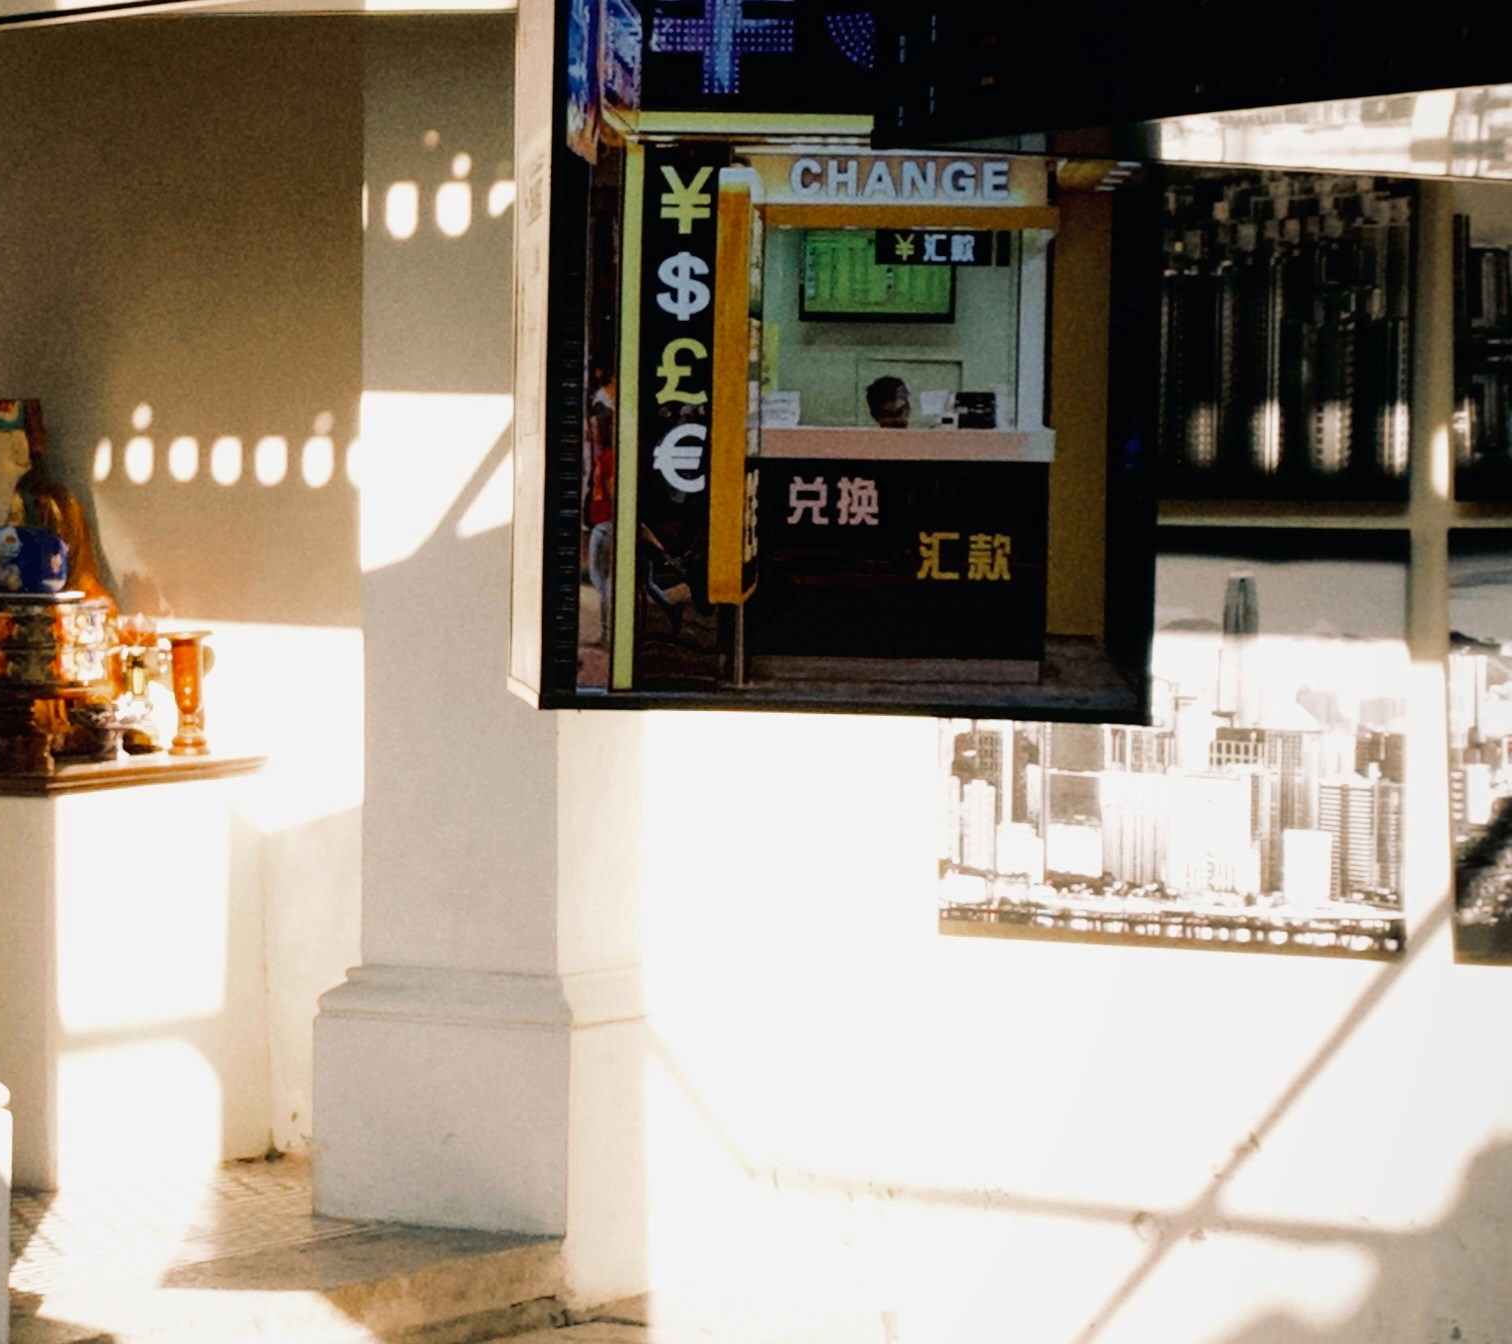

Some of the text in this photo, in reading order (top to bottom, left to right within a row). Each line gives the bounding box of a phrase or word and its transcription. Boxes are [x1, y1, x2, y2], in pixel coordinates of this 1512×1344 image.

[790, 157, 1009, 199] CHANGE
[652, 165, 714, 493] ¥ $ £ €
[787, 476, 879, 525] 兑换
[916, 532, 1011, 581] 汇款
